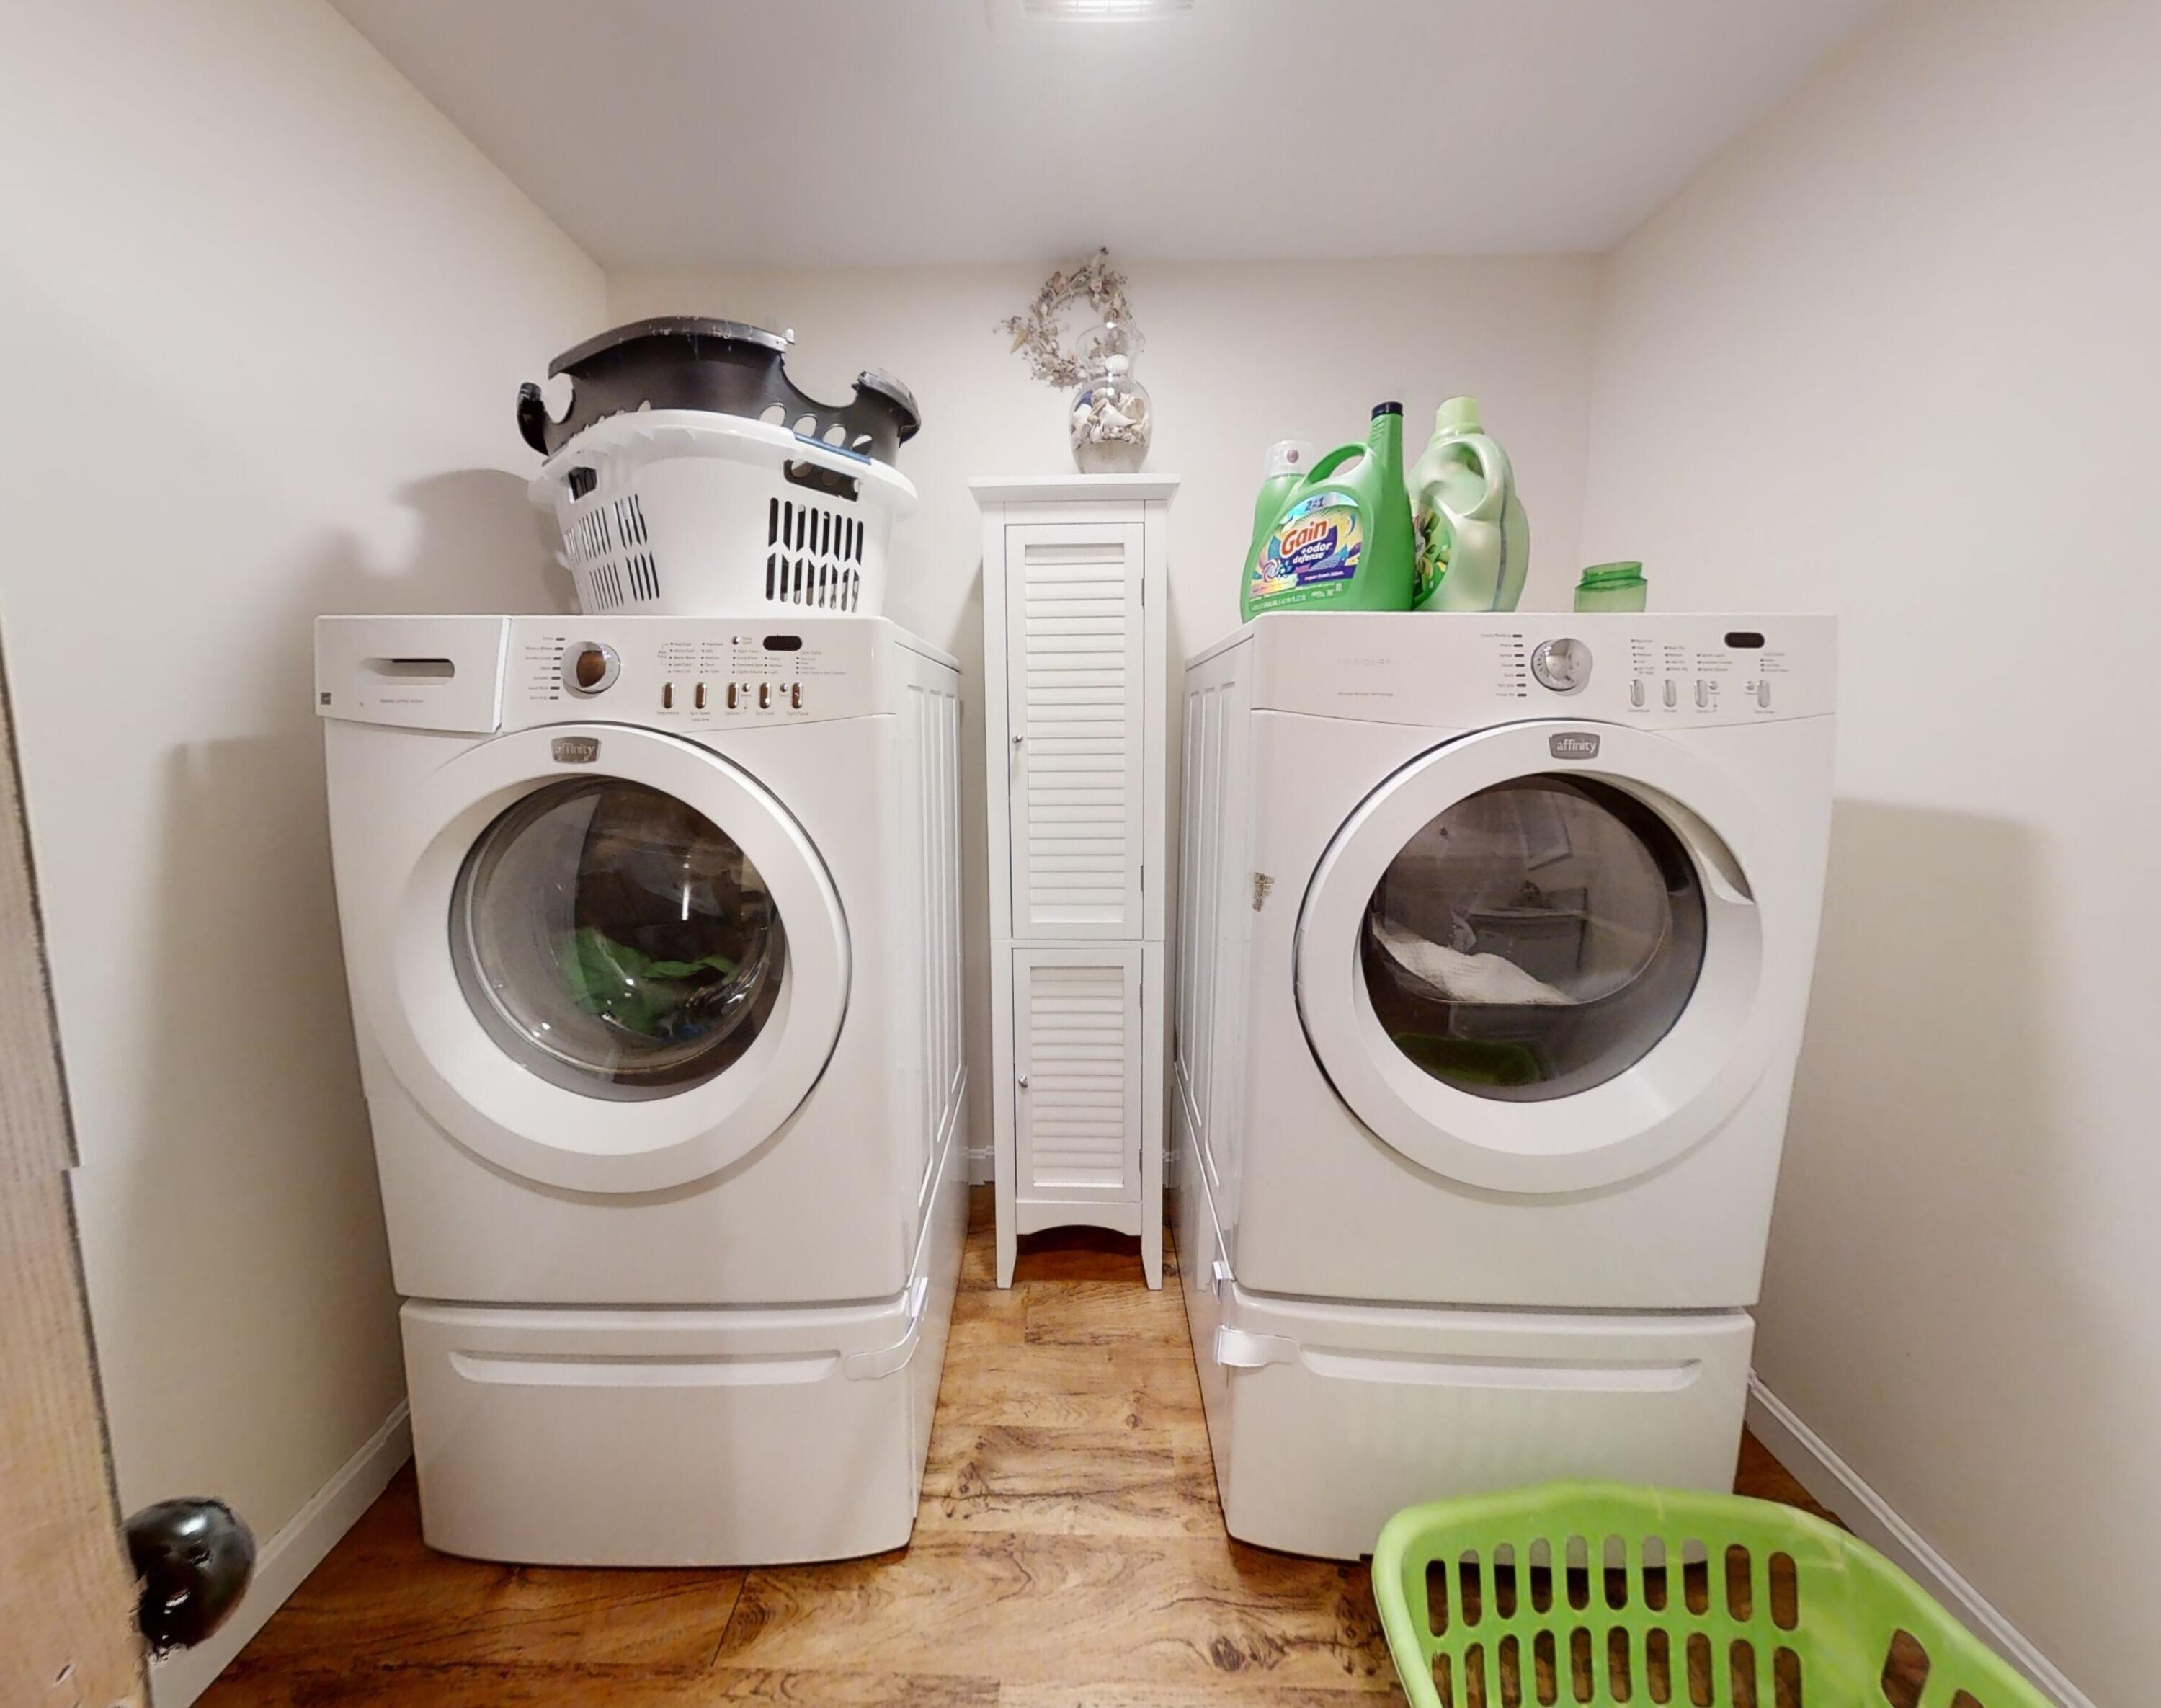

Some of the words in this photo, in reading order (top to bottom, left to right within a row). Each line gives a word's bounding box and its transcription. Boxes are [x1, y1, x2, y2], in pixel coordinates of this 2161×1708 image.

[1281, 520, 1327, 556] Gain
[1292, 552, 1326, 564] defense
[1556, 739, 1597, 754] affinity
